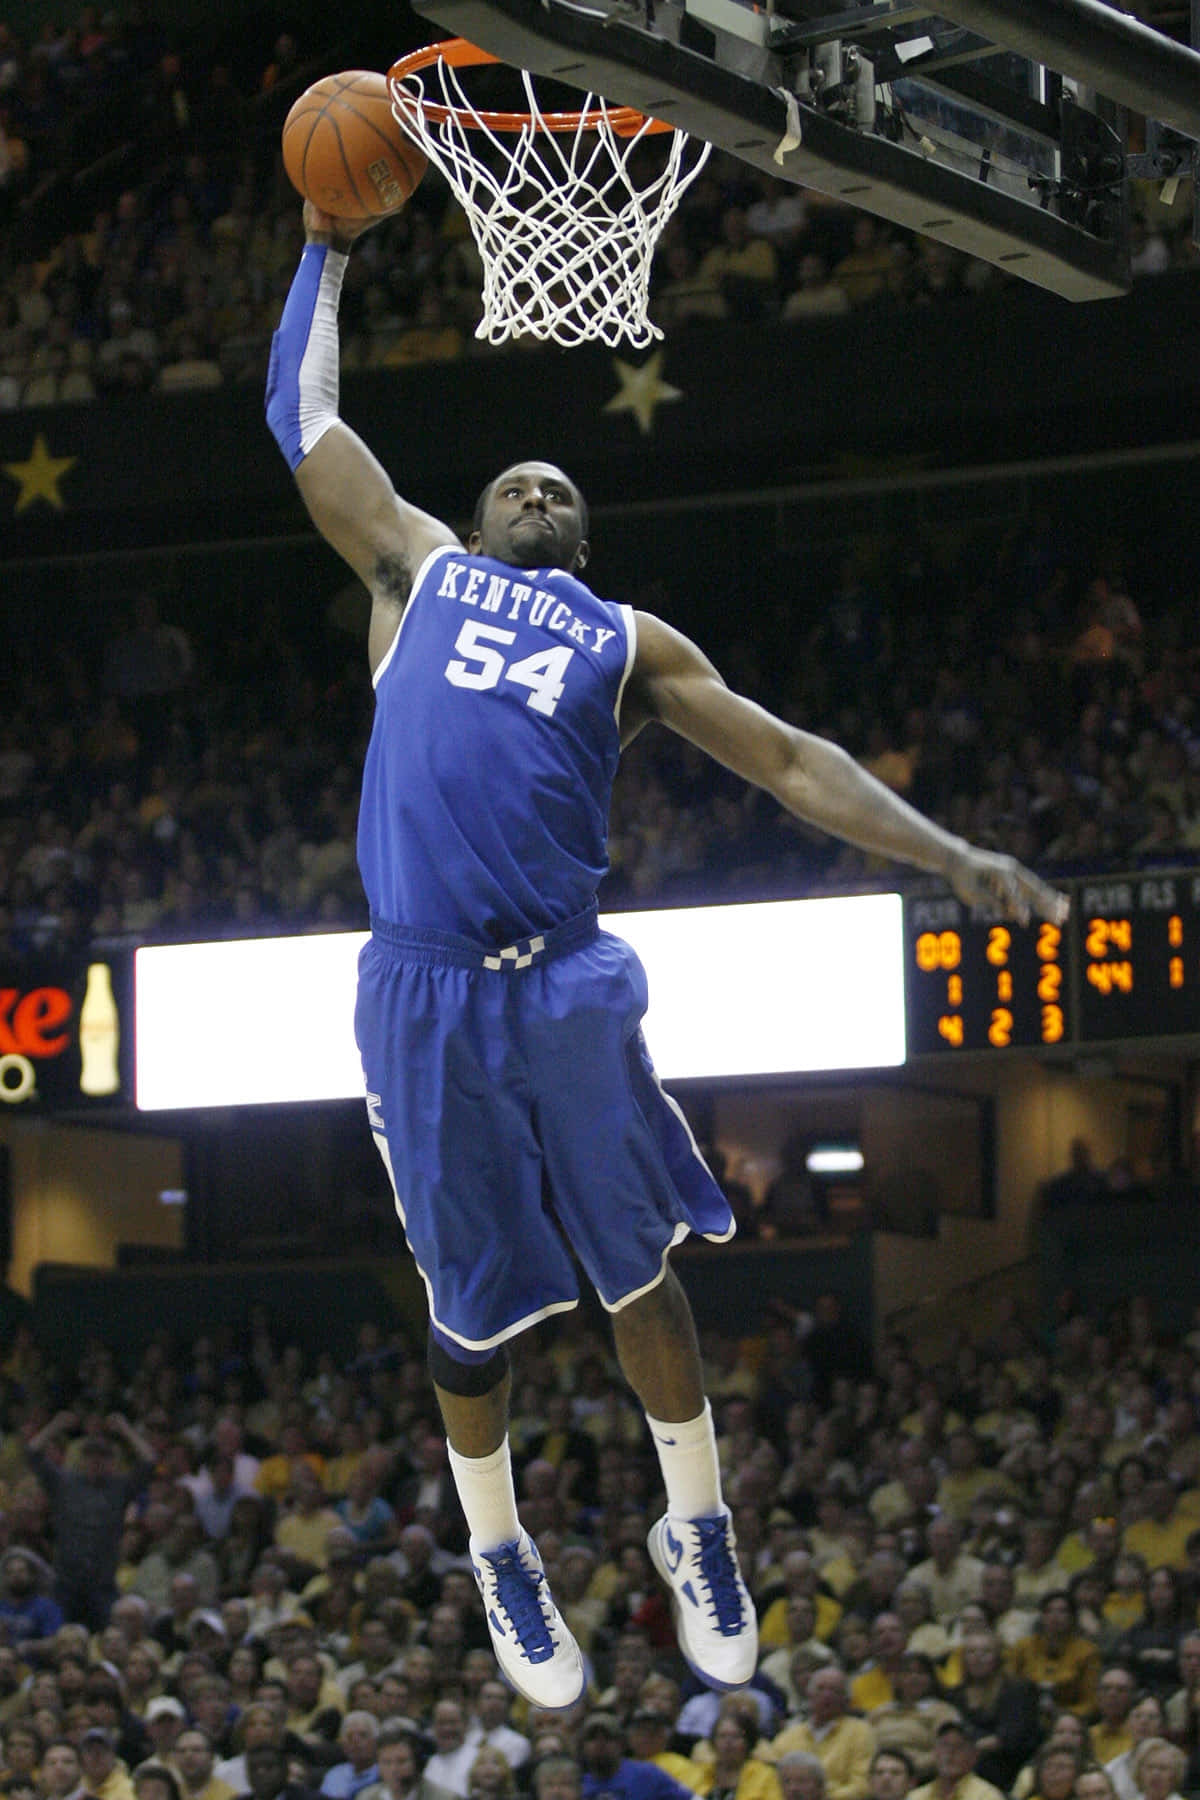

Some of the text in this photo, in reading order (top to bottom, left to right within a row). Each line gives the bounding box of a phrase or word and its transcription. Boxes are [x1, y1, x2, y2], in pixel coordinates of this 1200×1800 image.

[437, 562, 616, 653] KENTUCKY
[444, 618, 575, 717] 54
[987, 926, 1011, 966] 2
[1037, 922, 1062, 962] 2
[1086, 915, 1183, 958] 24 1
[948, 963, 1062, 1007] 1 1 2
[1087, 956, 1184, 995] 44 1
[938, 1004, 1064, 1048] 4 2 3
